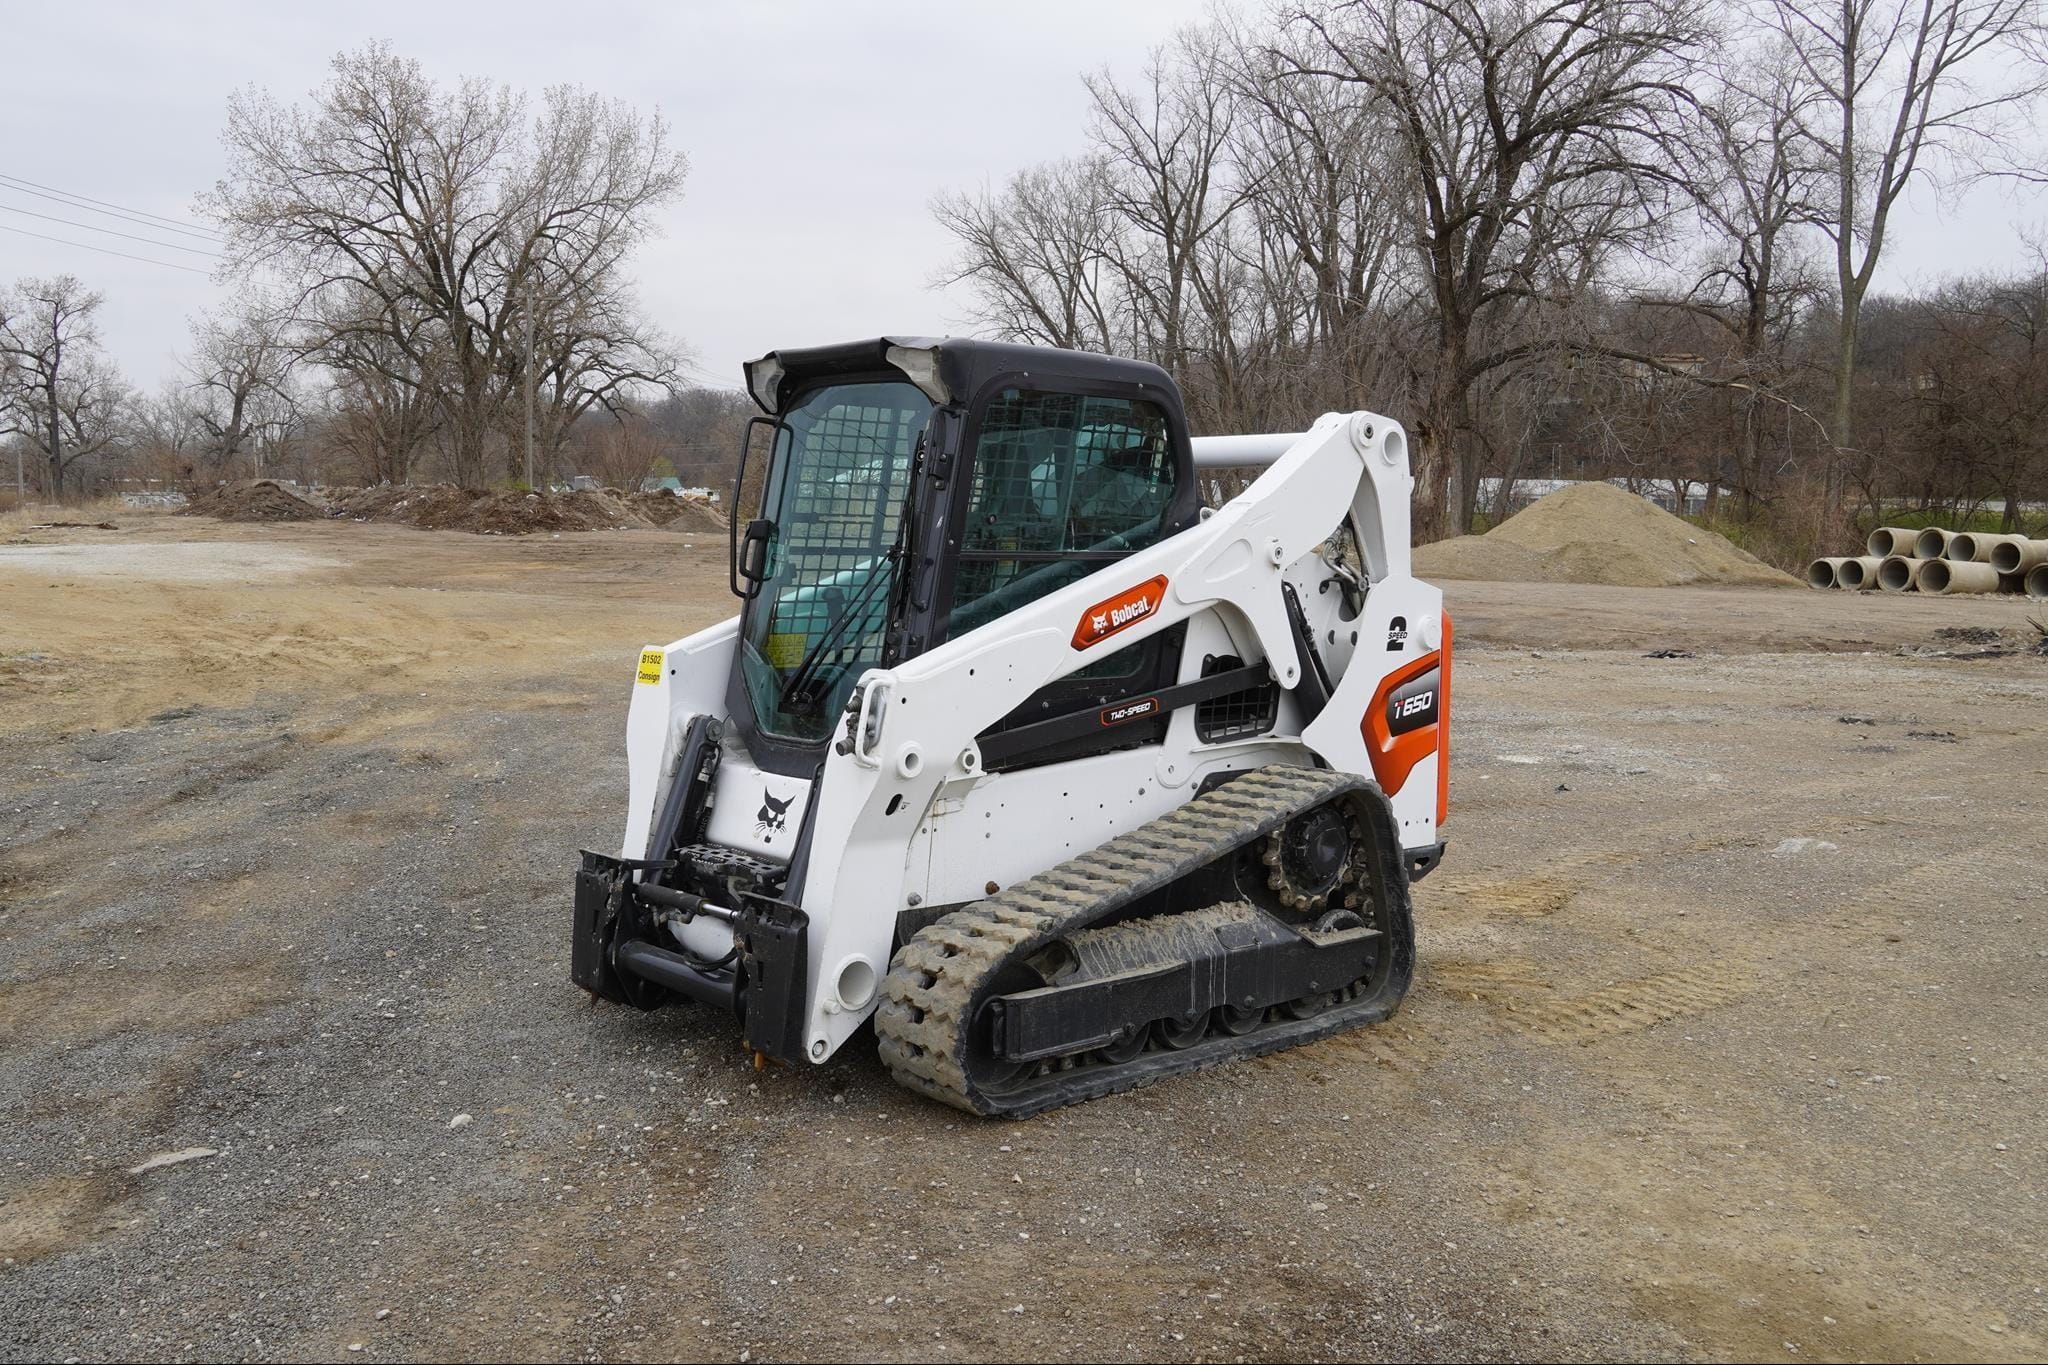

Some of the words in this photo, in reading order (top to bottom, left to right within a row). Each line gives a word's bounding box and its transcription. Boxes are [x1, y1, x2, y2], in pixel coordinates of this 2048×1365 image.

[1111, 596, 1149, 627] Bobcat
[1386, 616, 1406, 651] 2
[1388, 631, 1408, 640] SPEED
[642, 654, 662, 664] B1502
[638, 671, 660, 683] Consign
[1111, 702, 1151, 720] TWO-SPEED
[1395, 691, 1433, 719] T650
